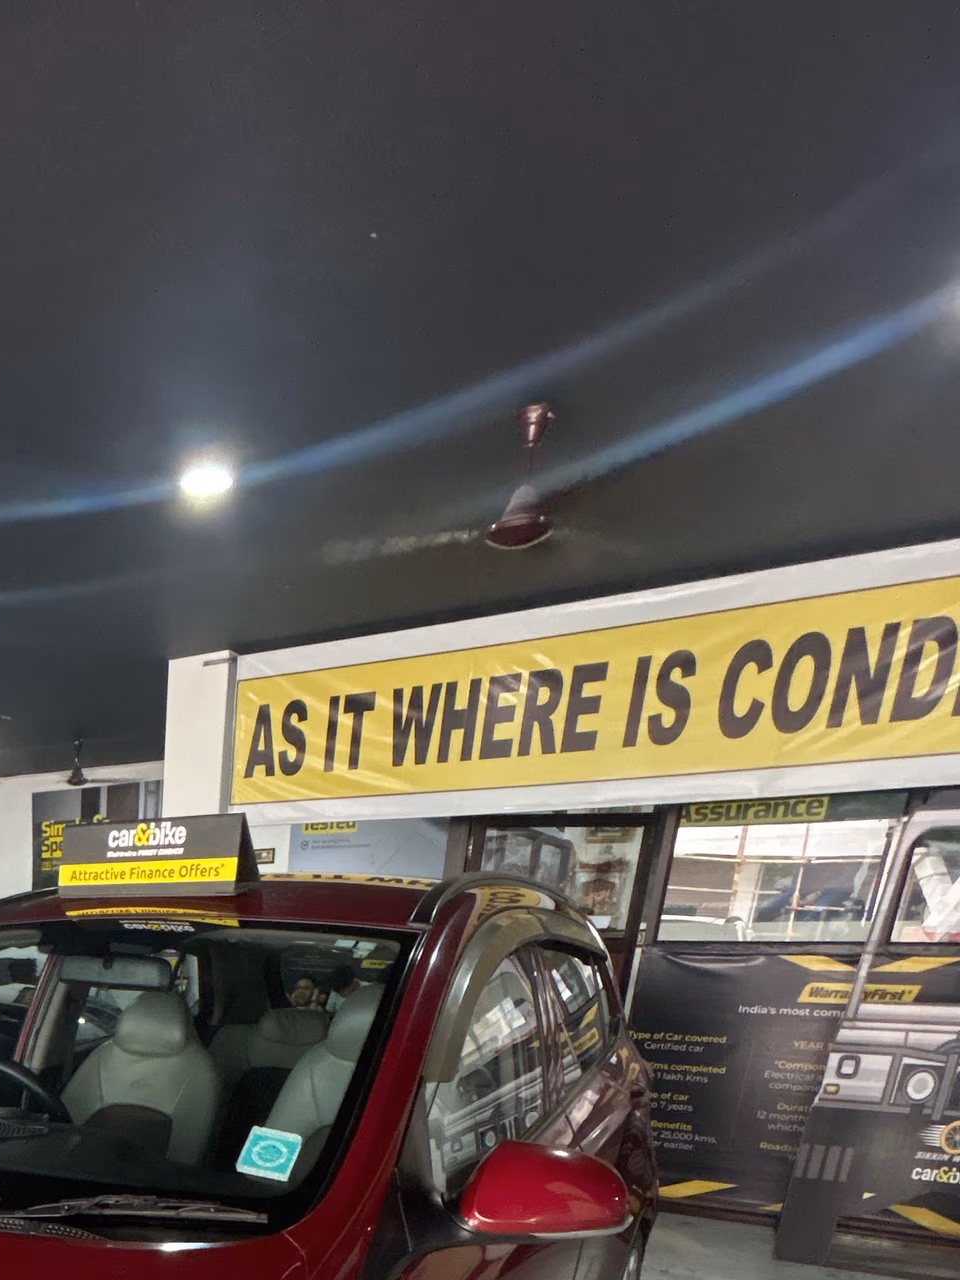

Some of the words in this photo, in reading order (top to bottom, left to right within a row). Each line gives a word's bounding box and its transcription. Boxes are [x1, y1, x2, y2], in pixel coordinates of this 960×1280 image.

[243, 699, 308, 779] AS
[323, 691, 376, 772] IT
[392, 661, 609, 767] WHERE
[622, 649, 696, 748] IS
[718, 616, 960, 739] COND
[108, 821, 187, 848] car&bike
[70, 867, 126, 881] Attractive
[129, 866, 176, 879] Finance
[738, 1005, 776, 1015] India's
[779, 1008, 809, 1016] most
[628, 1031, 651, 1040] Type
[685, 1035, 727, 1044] covered
[644, 1041, 686, 1052] Certified
[688, 1045, 704, 1053] car
[671, 1064, 727, 1075] completed
[662, 1072, 683, 1081] lakh
[686, 1075, 709, 1083] Kms
[666, 1103, 693, 1111] years
[650, 1120, 693, 1131] Benefits
[912, 1166, 960, 1184] car&b
